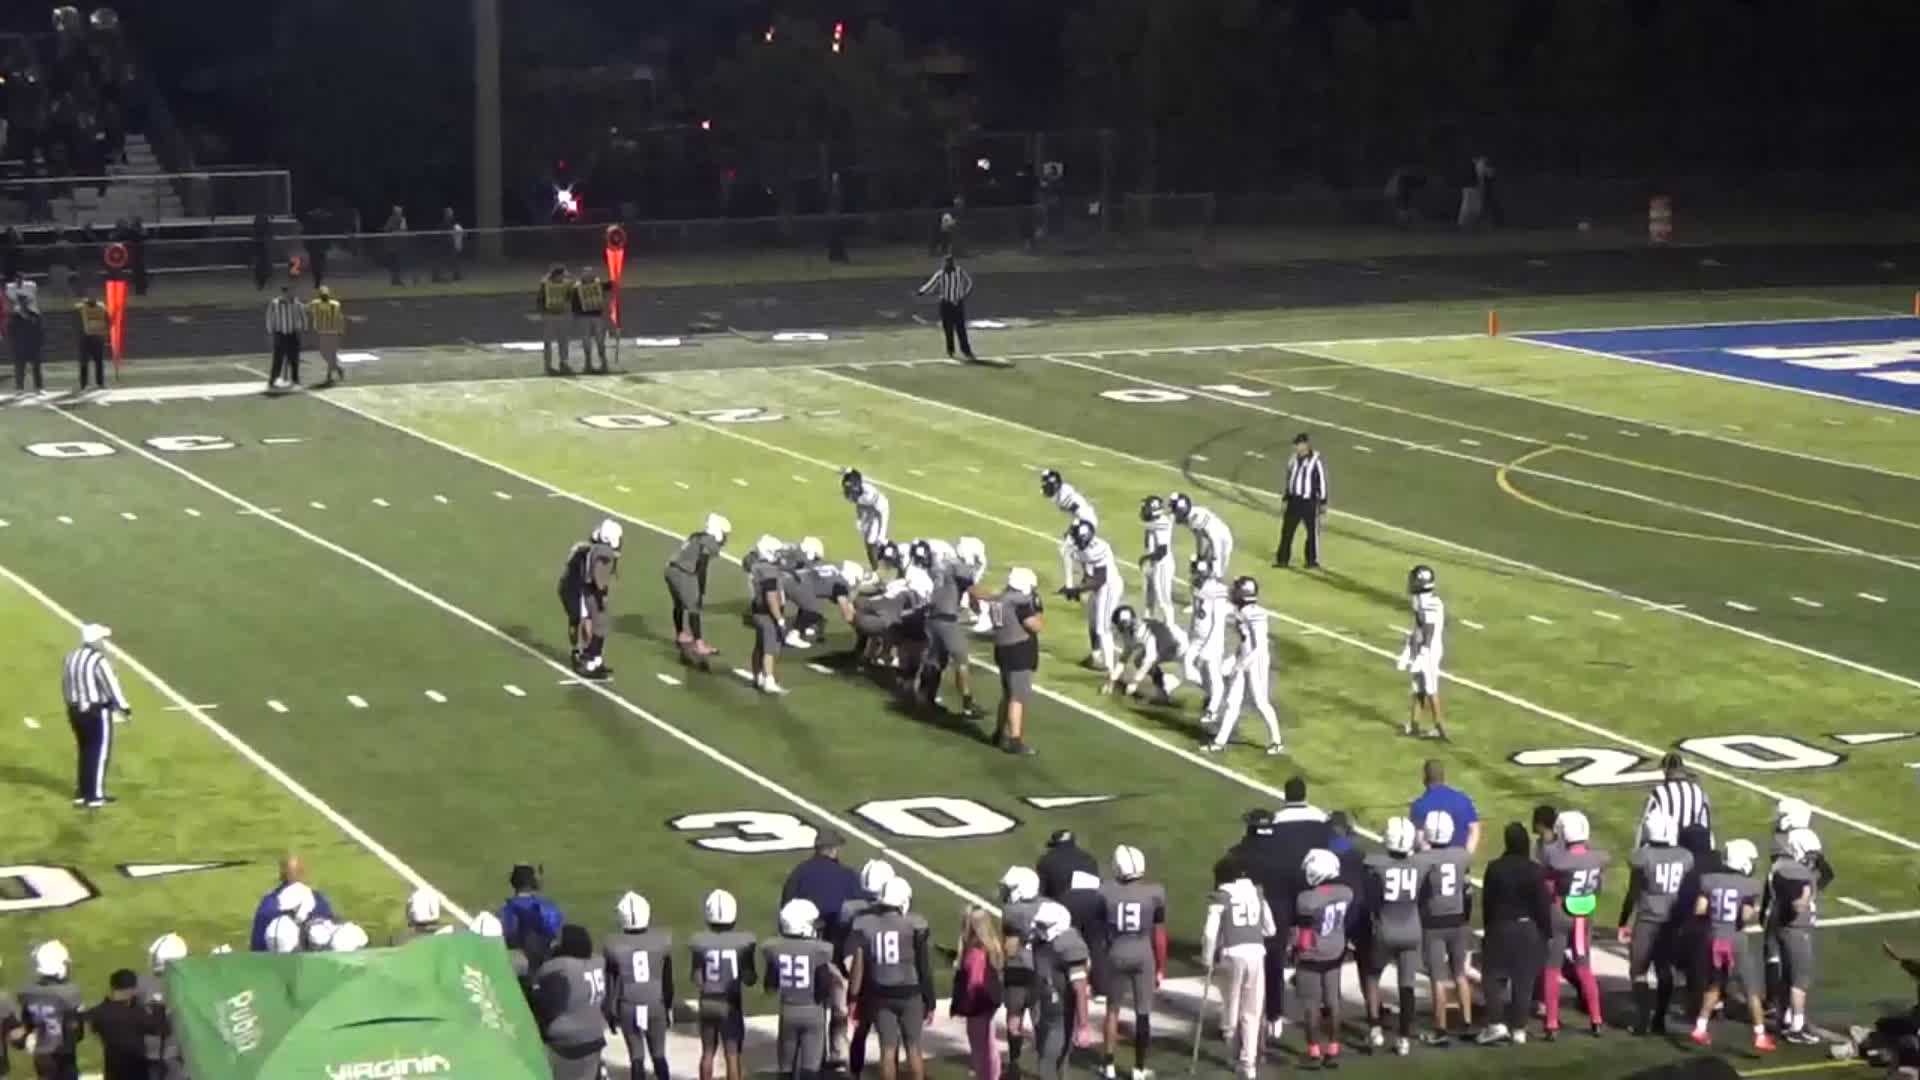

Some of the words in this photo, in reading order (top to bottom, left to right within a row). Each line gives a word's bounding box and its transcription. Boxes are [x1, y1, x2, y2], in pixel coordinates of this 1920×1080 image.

[1513, 734, 1841, 786] 20
[672, 797, 1016, 852] 30
[1384, 867, 1417, 901] 34
[1441, 863, 1456, 896] 2
[1655, 862, 1683, 893] 48
[1117, 902, 1141, 931] 13
[876, 931, 899, 964] 18
[632, 951, 650, 982] 8
[705, 949, 738, 982] 27
[778, 954, 810, 988] 23
